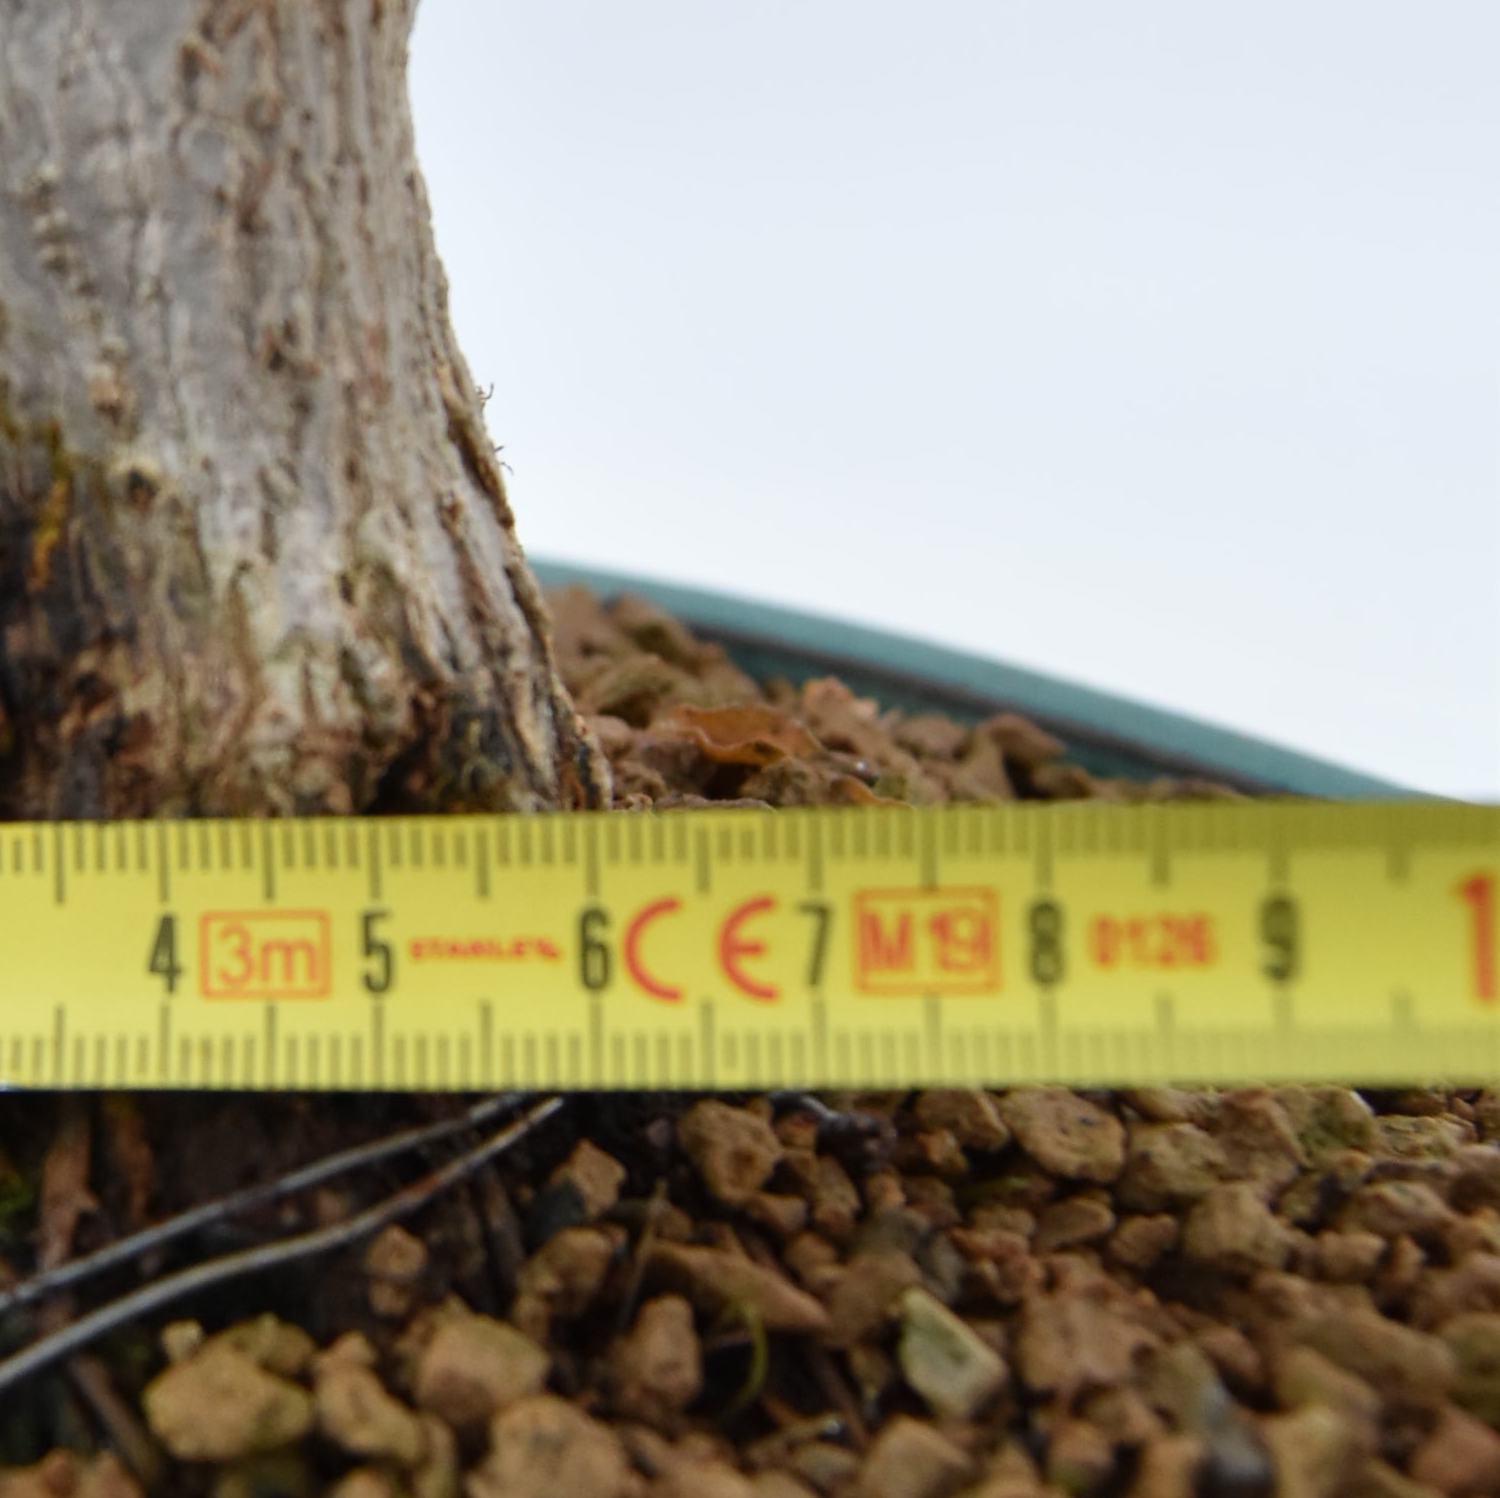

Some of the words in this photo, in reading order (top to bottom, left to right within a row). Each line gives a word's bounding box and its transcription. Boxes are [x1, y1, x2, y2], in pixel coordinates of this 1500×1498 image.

[148, 914, 182, 993] 4
[218, 924, 319, 988] 3m
[361, 910, 393, 992] 5
[578, 907, 611, 991] 6
[797, 901, 831, 986] 7
[1028, 899, 1065, 985] 8
[1260, 896, 1299, 983] 9
